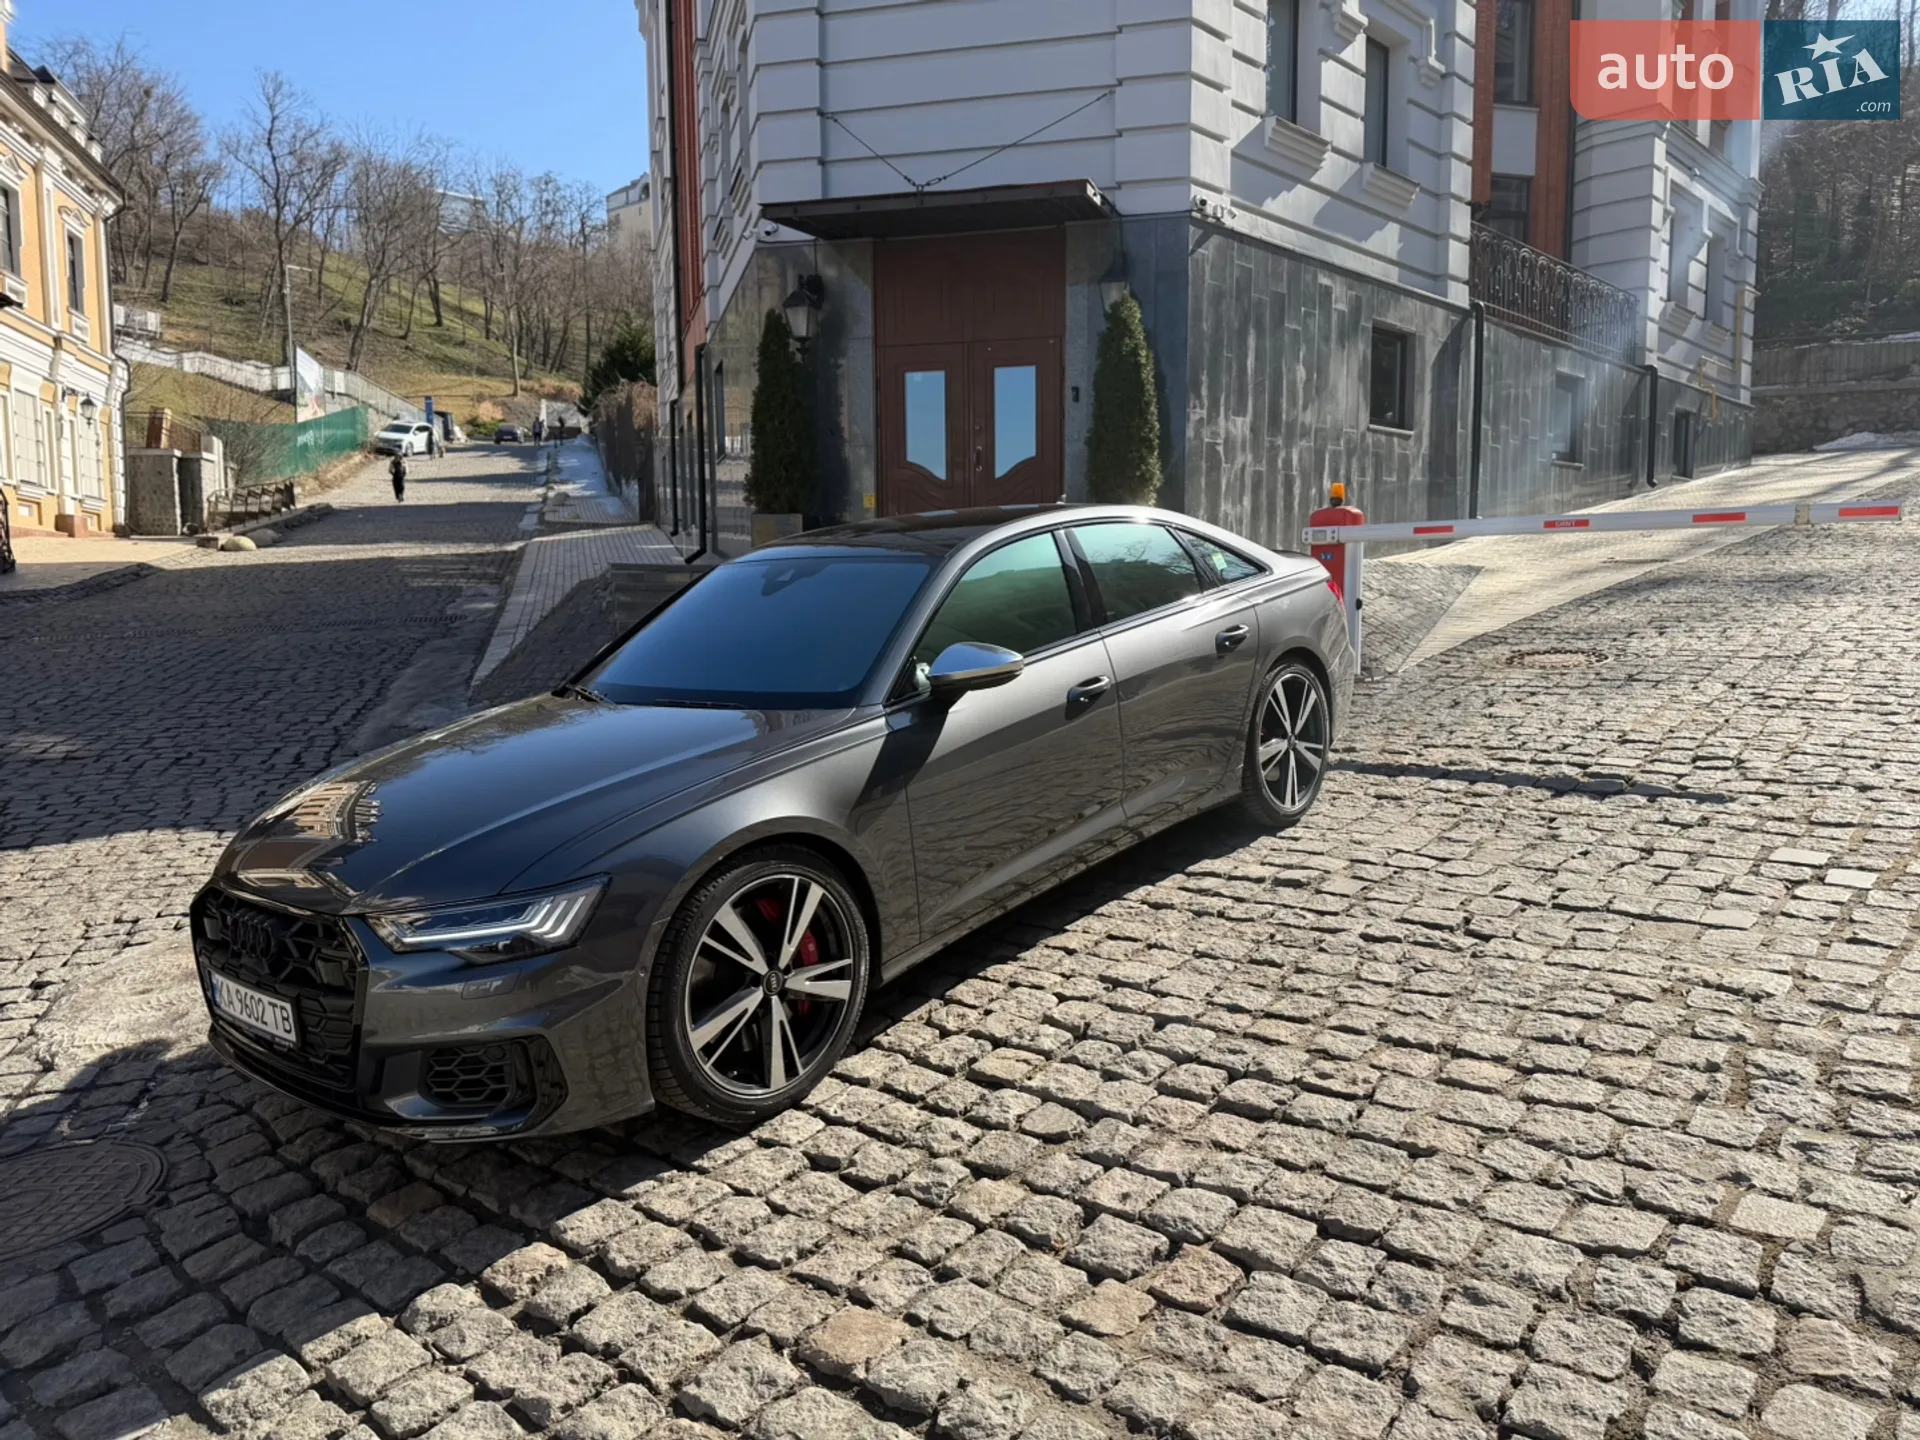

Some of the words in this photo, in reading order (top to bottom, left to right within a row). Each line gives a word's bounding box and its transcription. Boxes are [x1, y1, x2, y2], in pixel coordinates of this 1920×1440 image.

[219, 981, 236, 1012] KA
[235, 988, 268, 1026] 9602
[268, 1001, 292, 1034] TB
